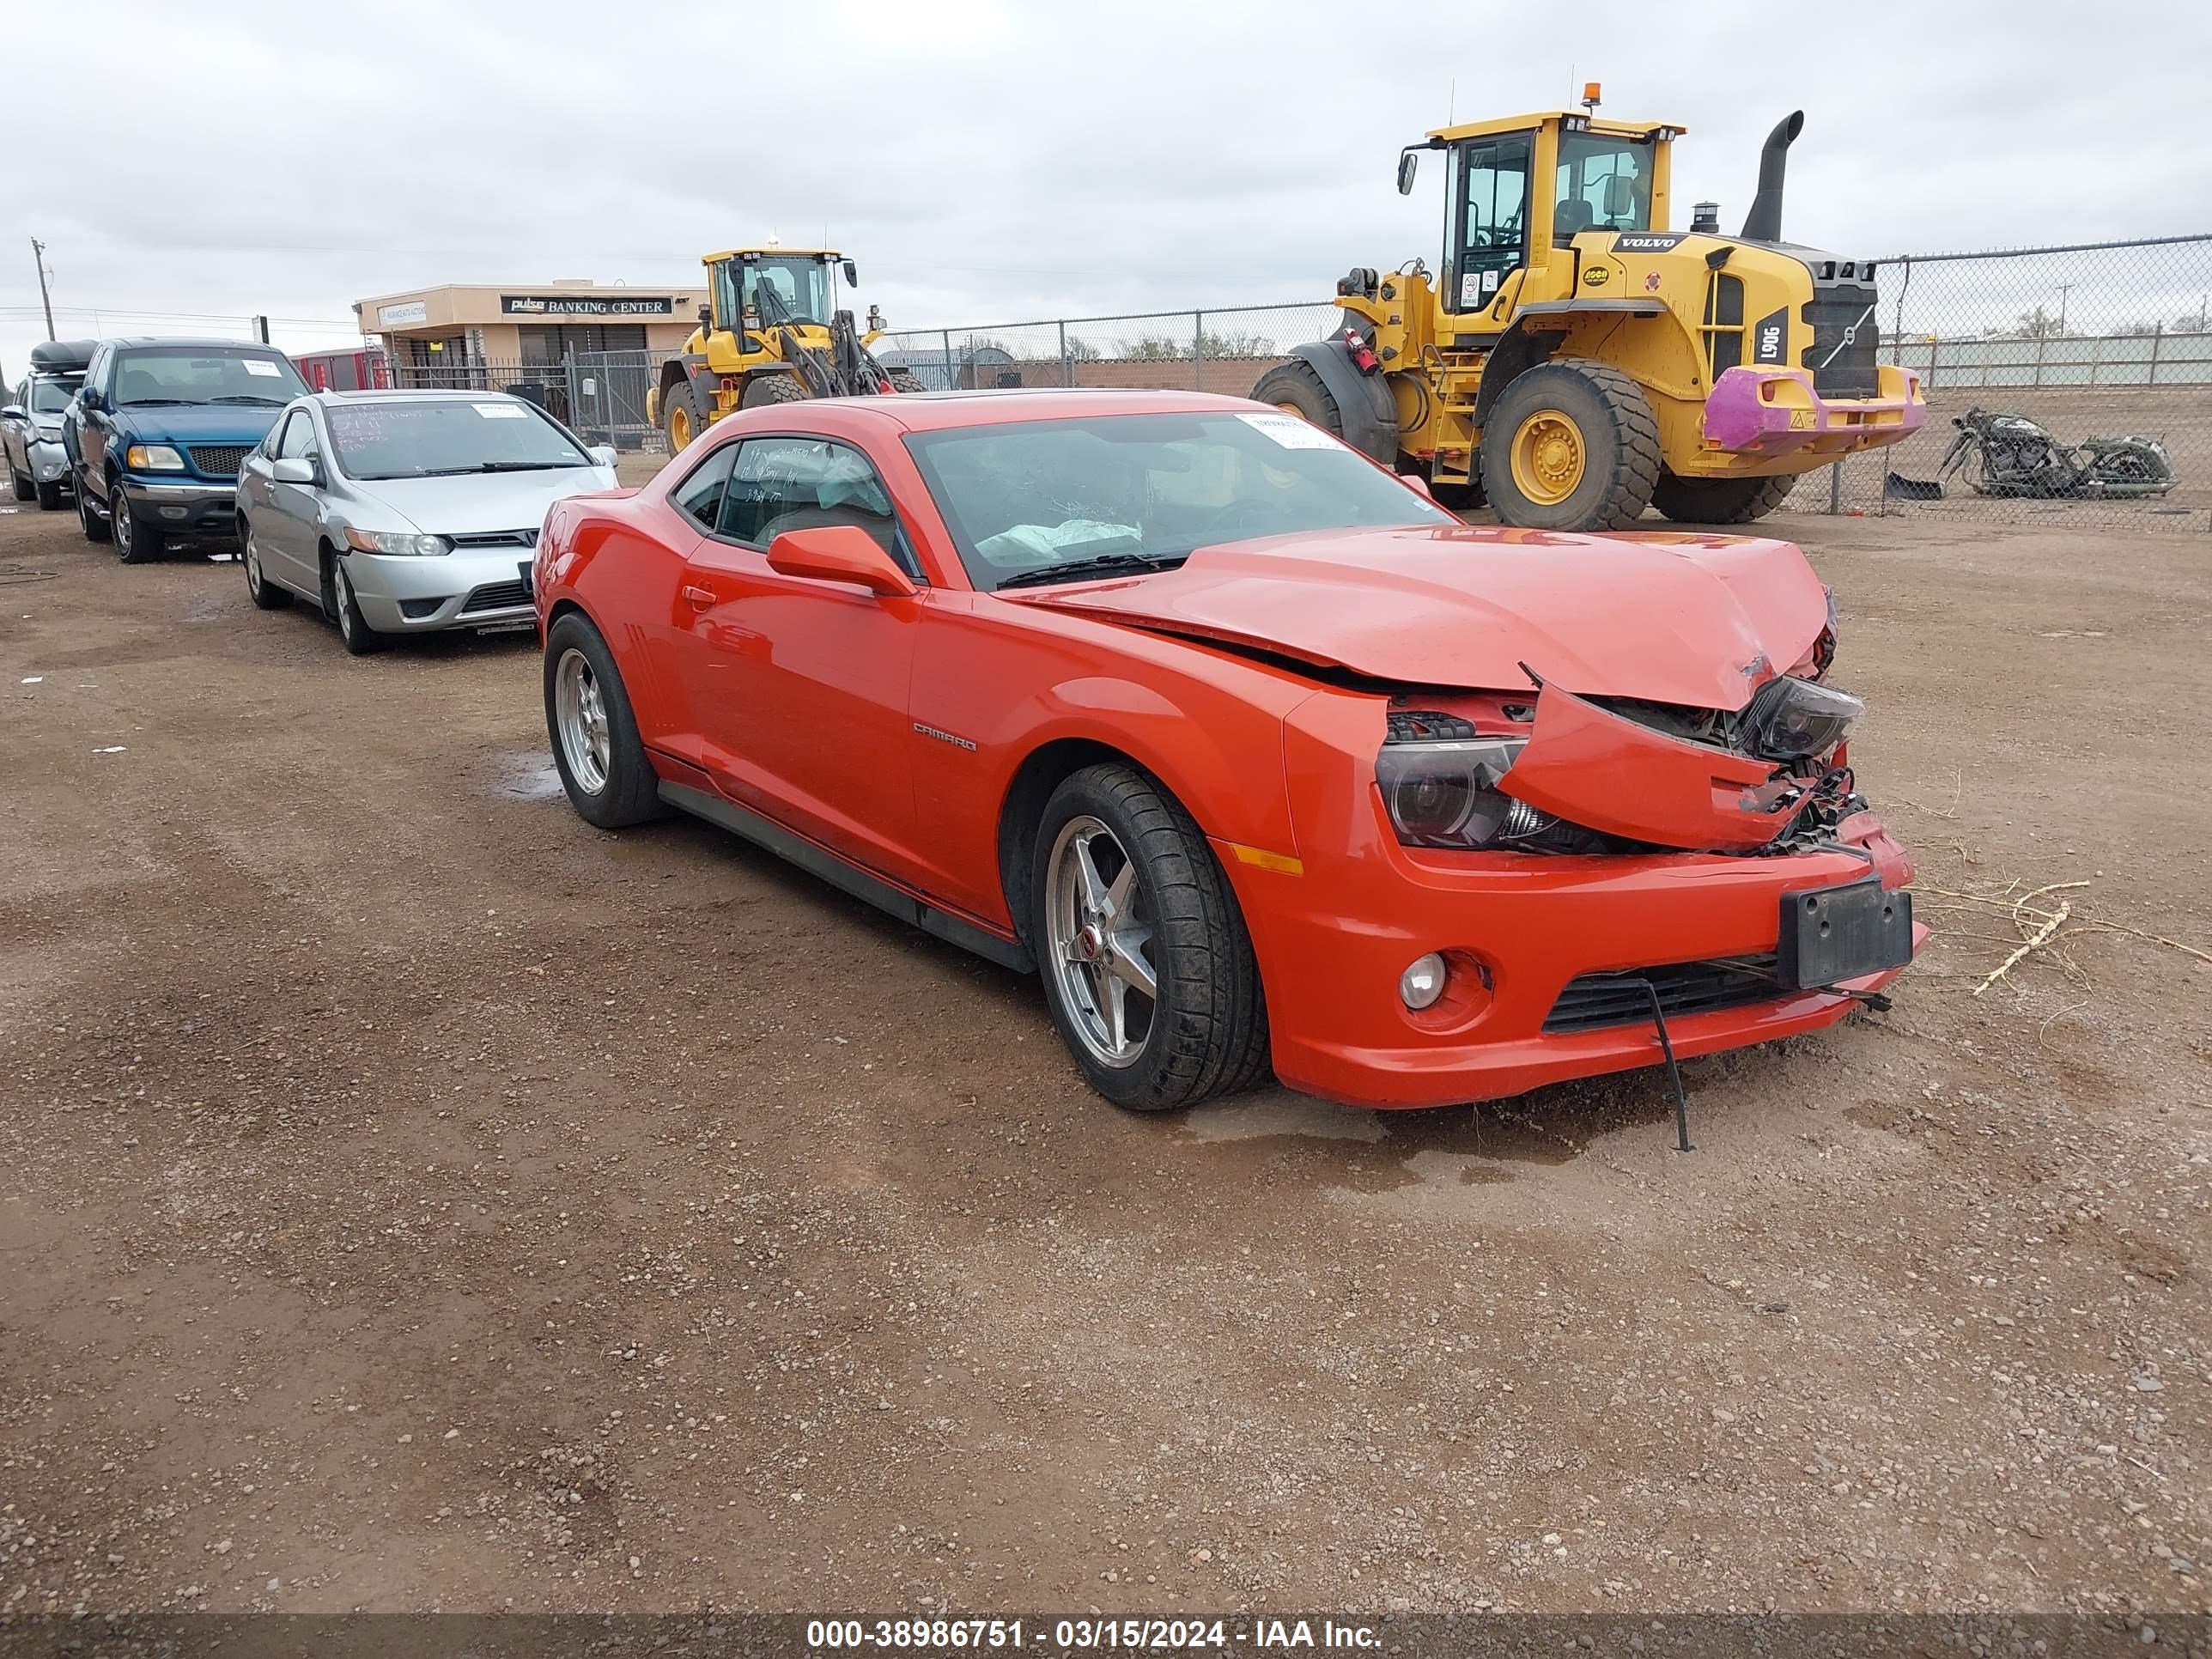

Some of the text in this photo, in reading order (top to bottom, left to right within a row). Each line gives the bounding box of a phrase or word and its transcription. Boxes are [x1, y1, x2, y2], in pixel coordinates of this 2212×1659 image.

[1622, 238, 1676, 247] VOLVO
[511, 297, 663, 313] pulse BANKING CENTER
[1760, 326, 1780, 358] L90G
[913, 722, 976, 751] CAMARO
